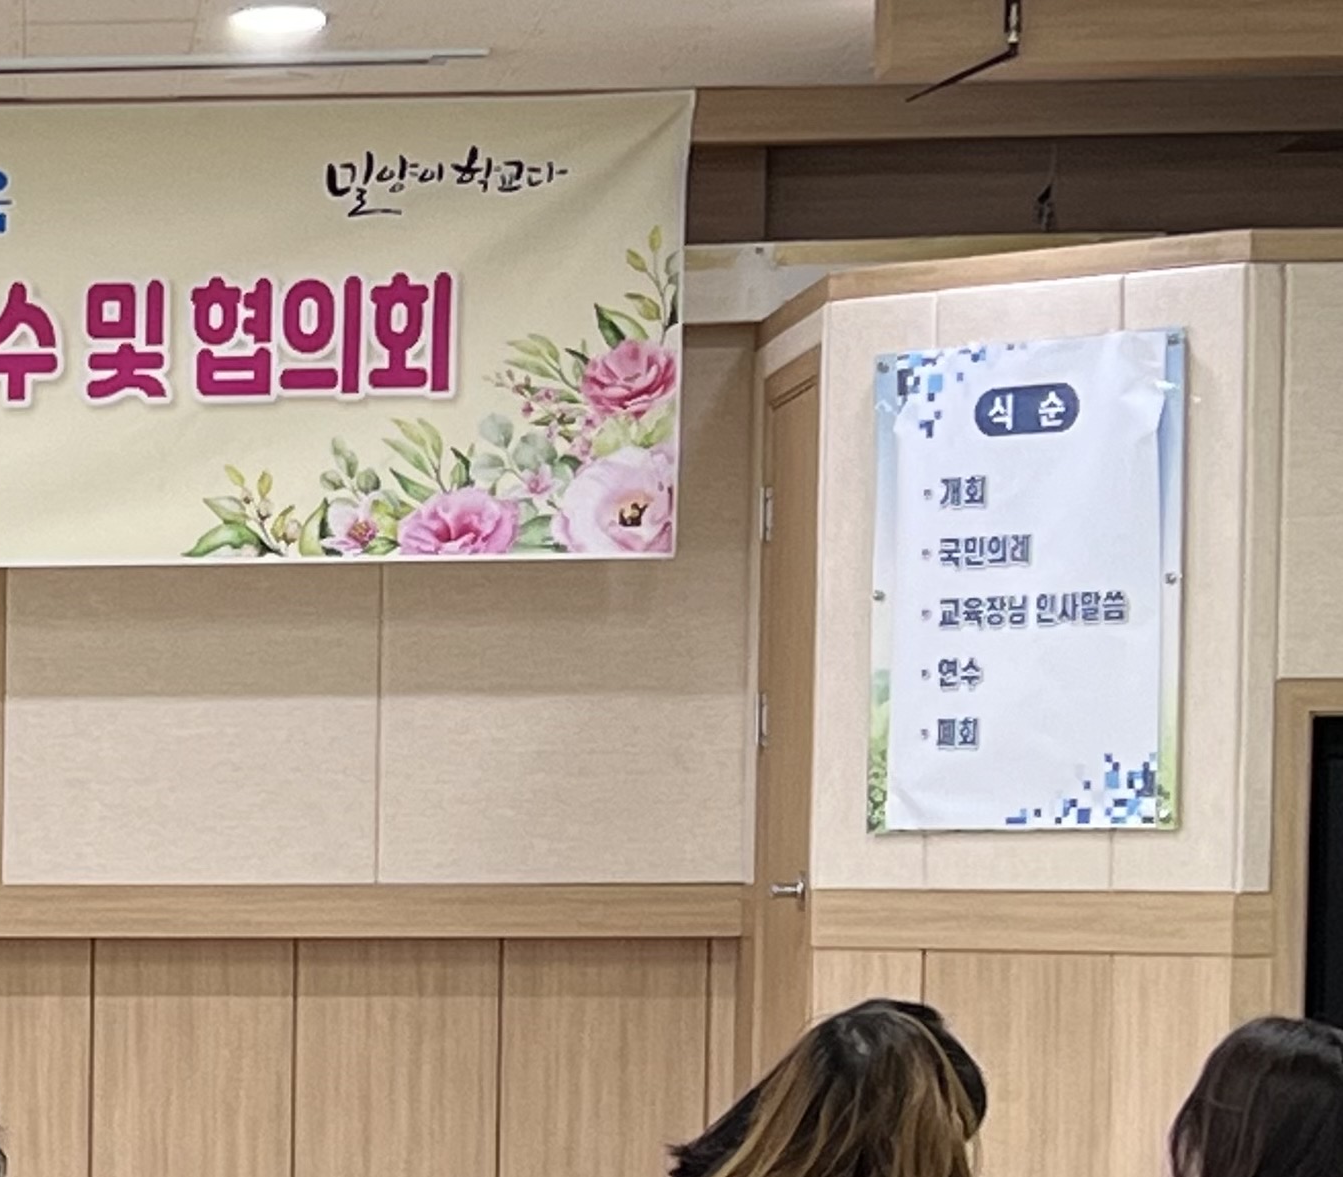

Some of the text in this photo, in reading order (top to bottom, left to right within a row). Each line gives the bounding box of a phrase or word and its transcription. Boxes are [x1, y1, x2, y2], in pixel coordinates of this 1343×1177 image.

[326, 145, 568, 218] 밀양이 학교다
[87, 280, 166, 398] 및
[191, 272, 451, 396] 협의회
[939, 475, 986, 506] 개회
[938, 533, 1031, 568] 국민의례
[938, 590, 1127, 628] 교육장님 인사말씀
[938, 658, 981, 688] 연수
